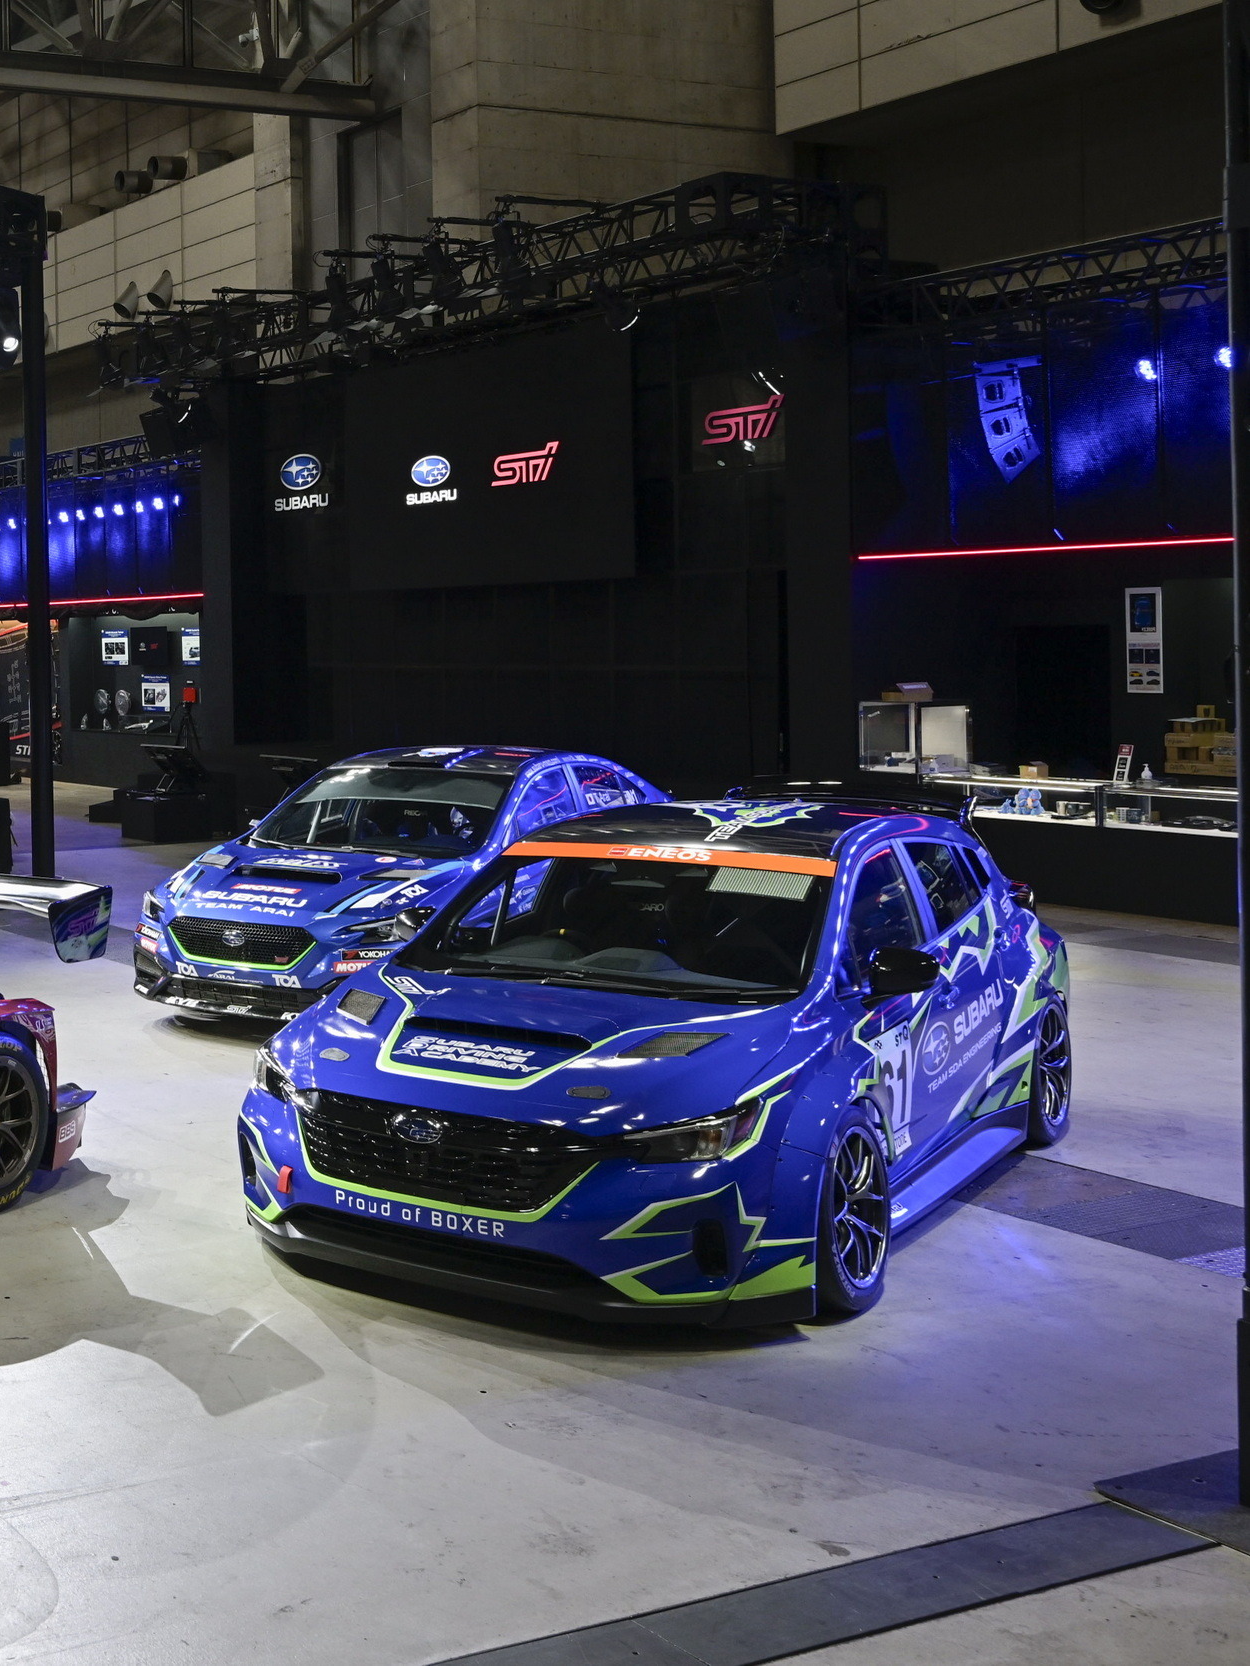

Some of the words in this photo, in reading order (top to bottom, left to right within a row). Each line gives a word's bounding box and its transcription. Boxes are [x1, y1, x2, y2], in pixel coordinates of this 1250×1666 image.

[491, 441, 559, 487] STI
[274, 493, 329, 512] SUBARU
[406, 488, 457, 506] SUBARU
[627, 847, 712, 863] ENEOS
[202, 890, 308, 908] SUBARU
[195, 902, 243, 910] TEAM
[250, 905, 295, 917] ARAI
[175, 961, 199, 977] TOA
[271, 974, 302, 988] TOA
[953, 978, 1003, 1045] SUBARU
[402, 1041, 528, 1063] DRIVING
[412, 1035, 535, 1056] SUBARU
[392, 1048, 542, 1073] ACADEMY
[928, 1071, 948, 1093] TEAM
[948, 1059, 963, 1077] SDA
[963, 1022, 1002, 1064] ENGINEERING
[60, 1121, 76, 1140] BBS
[335, 1189, 390, 1218] Proud
[402, 1205, 421, 1224] of
[432, 1210, 505, 1238] BOXER
